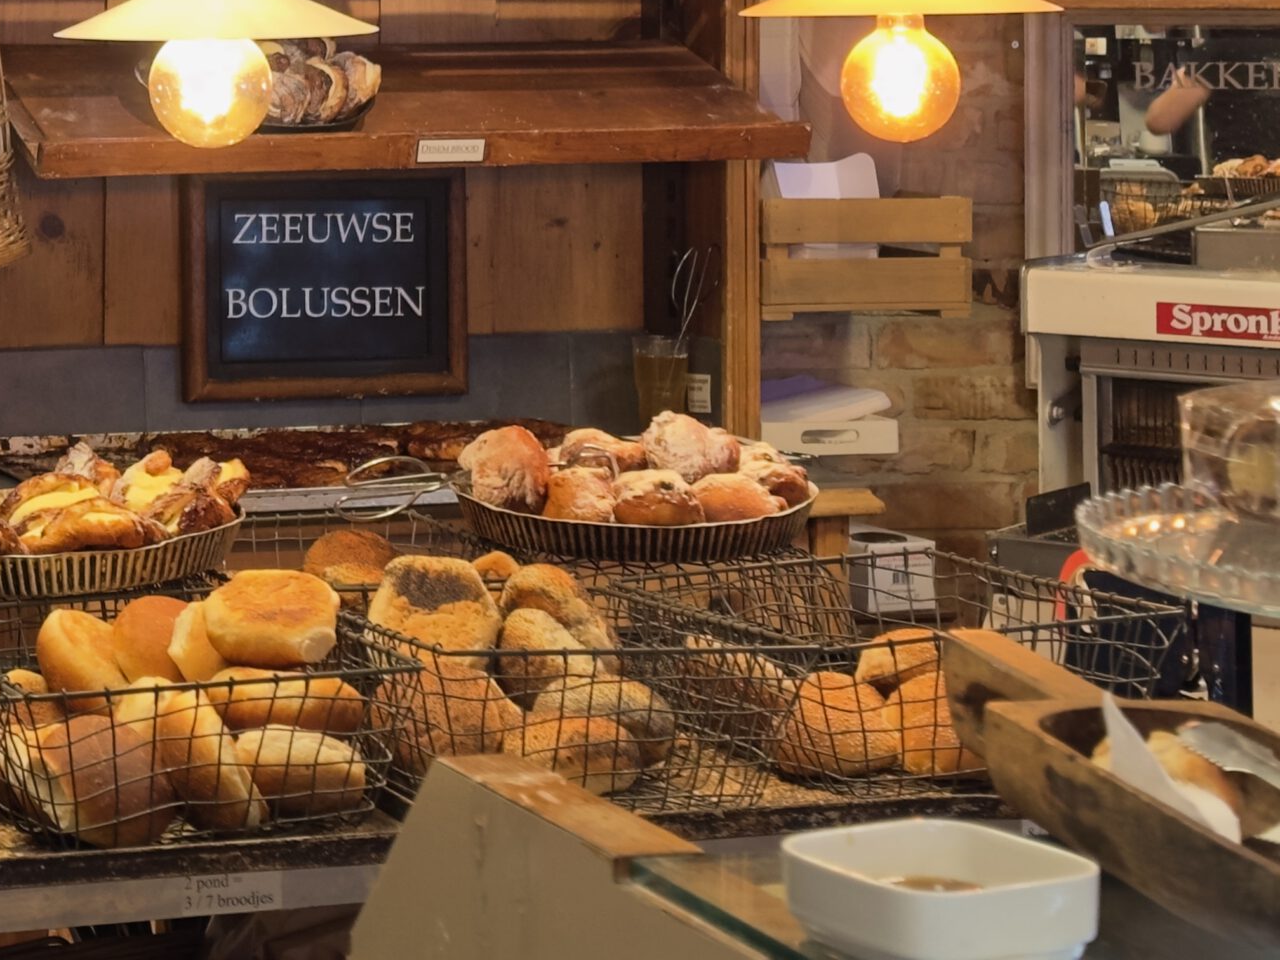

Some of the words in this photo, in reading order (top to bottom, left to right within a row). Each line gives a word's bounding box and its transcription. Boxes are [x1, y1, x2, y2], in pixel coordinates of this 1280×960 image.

[232, 212, 415, 244] ZEEUWSE
[225, 286, 425, 319] BOLUSSEN
[197, 874, 229, 893] pond
[217, 891, 274, 908] broodjes
